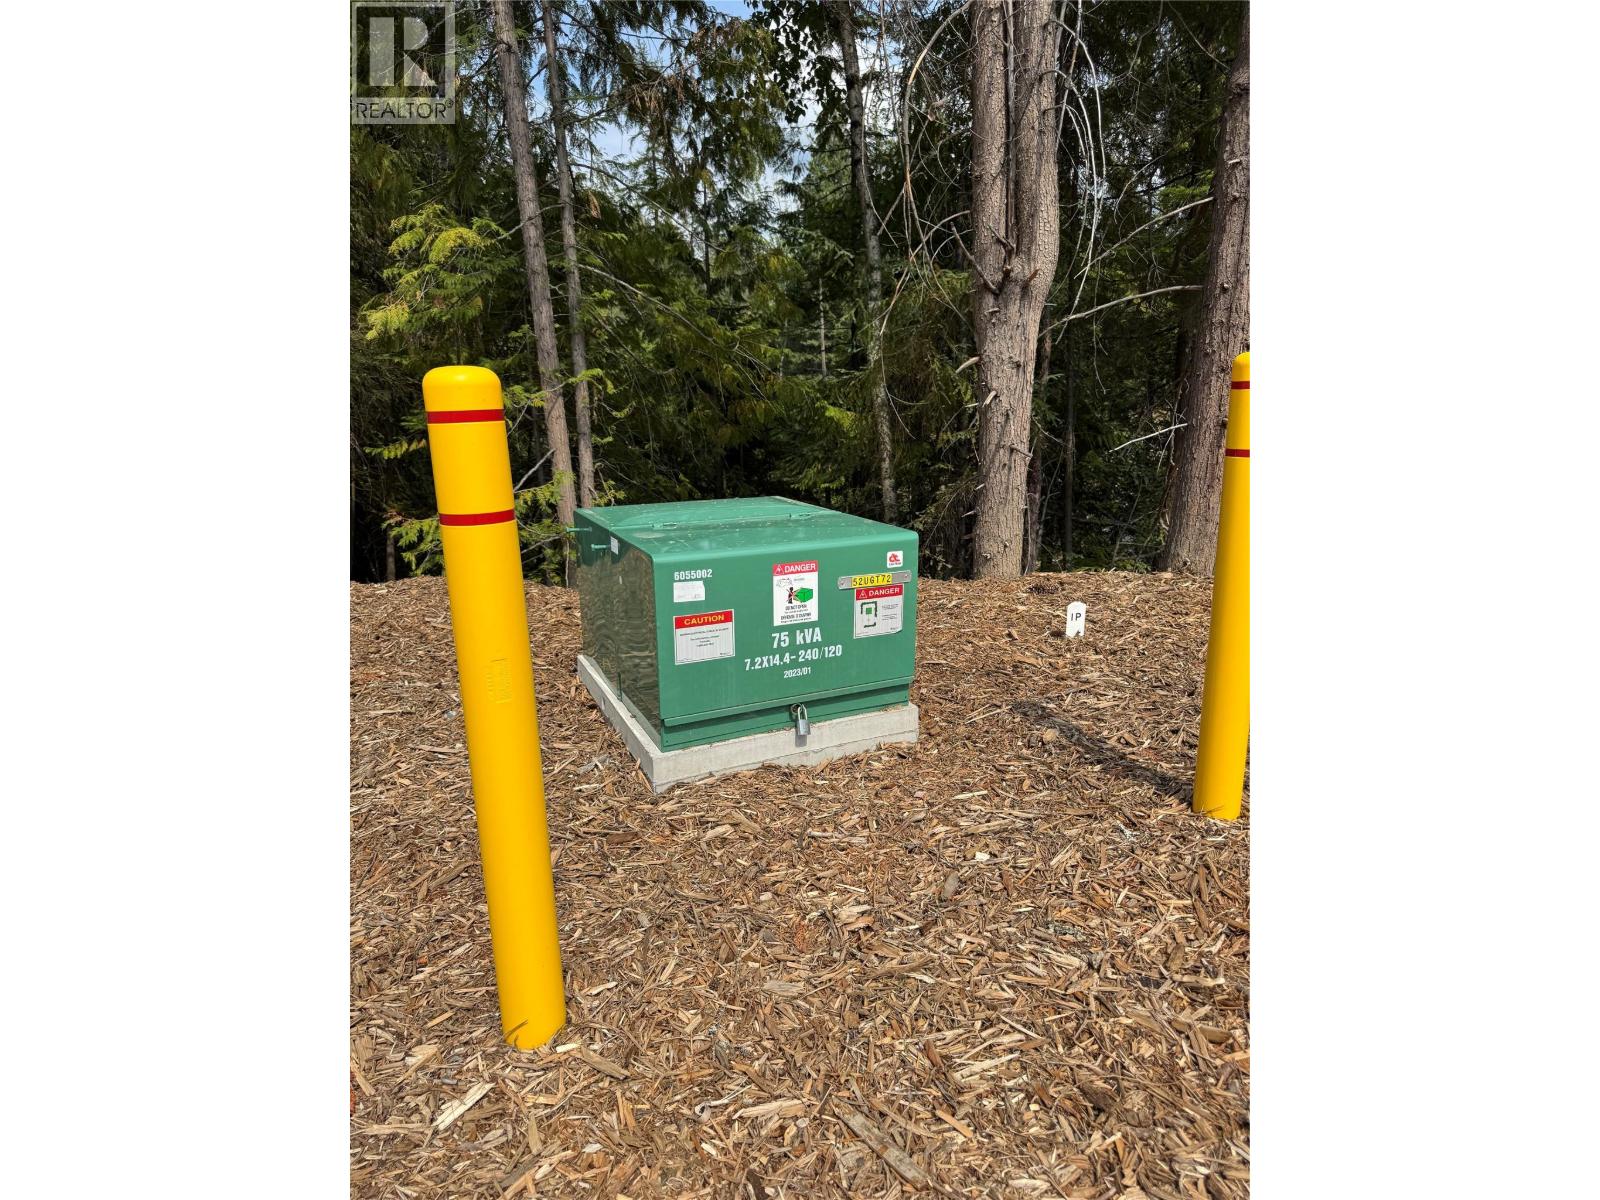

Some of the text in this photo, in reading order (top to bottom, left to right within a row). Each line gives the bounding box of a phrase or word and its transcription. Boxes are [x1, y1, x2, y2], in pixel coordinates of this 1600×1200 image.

[674, 568, 713, 581] 6055002
[784, 563, 816, 573] DANGER
[852, 574, 891, 587] 52UGT72
[868, 587, 900, 597] DANGER
[683, 614, 725, 626] CAUTION
[771, 626, 822, 649] 75 kVA
[783, 666, 812, 679] 2023/01
